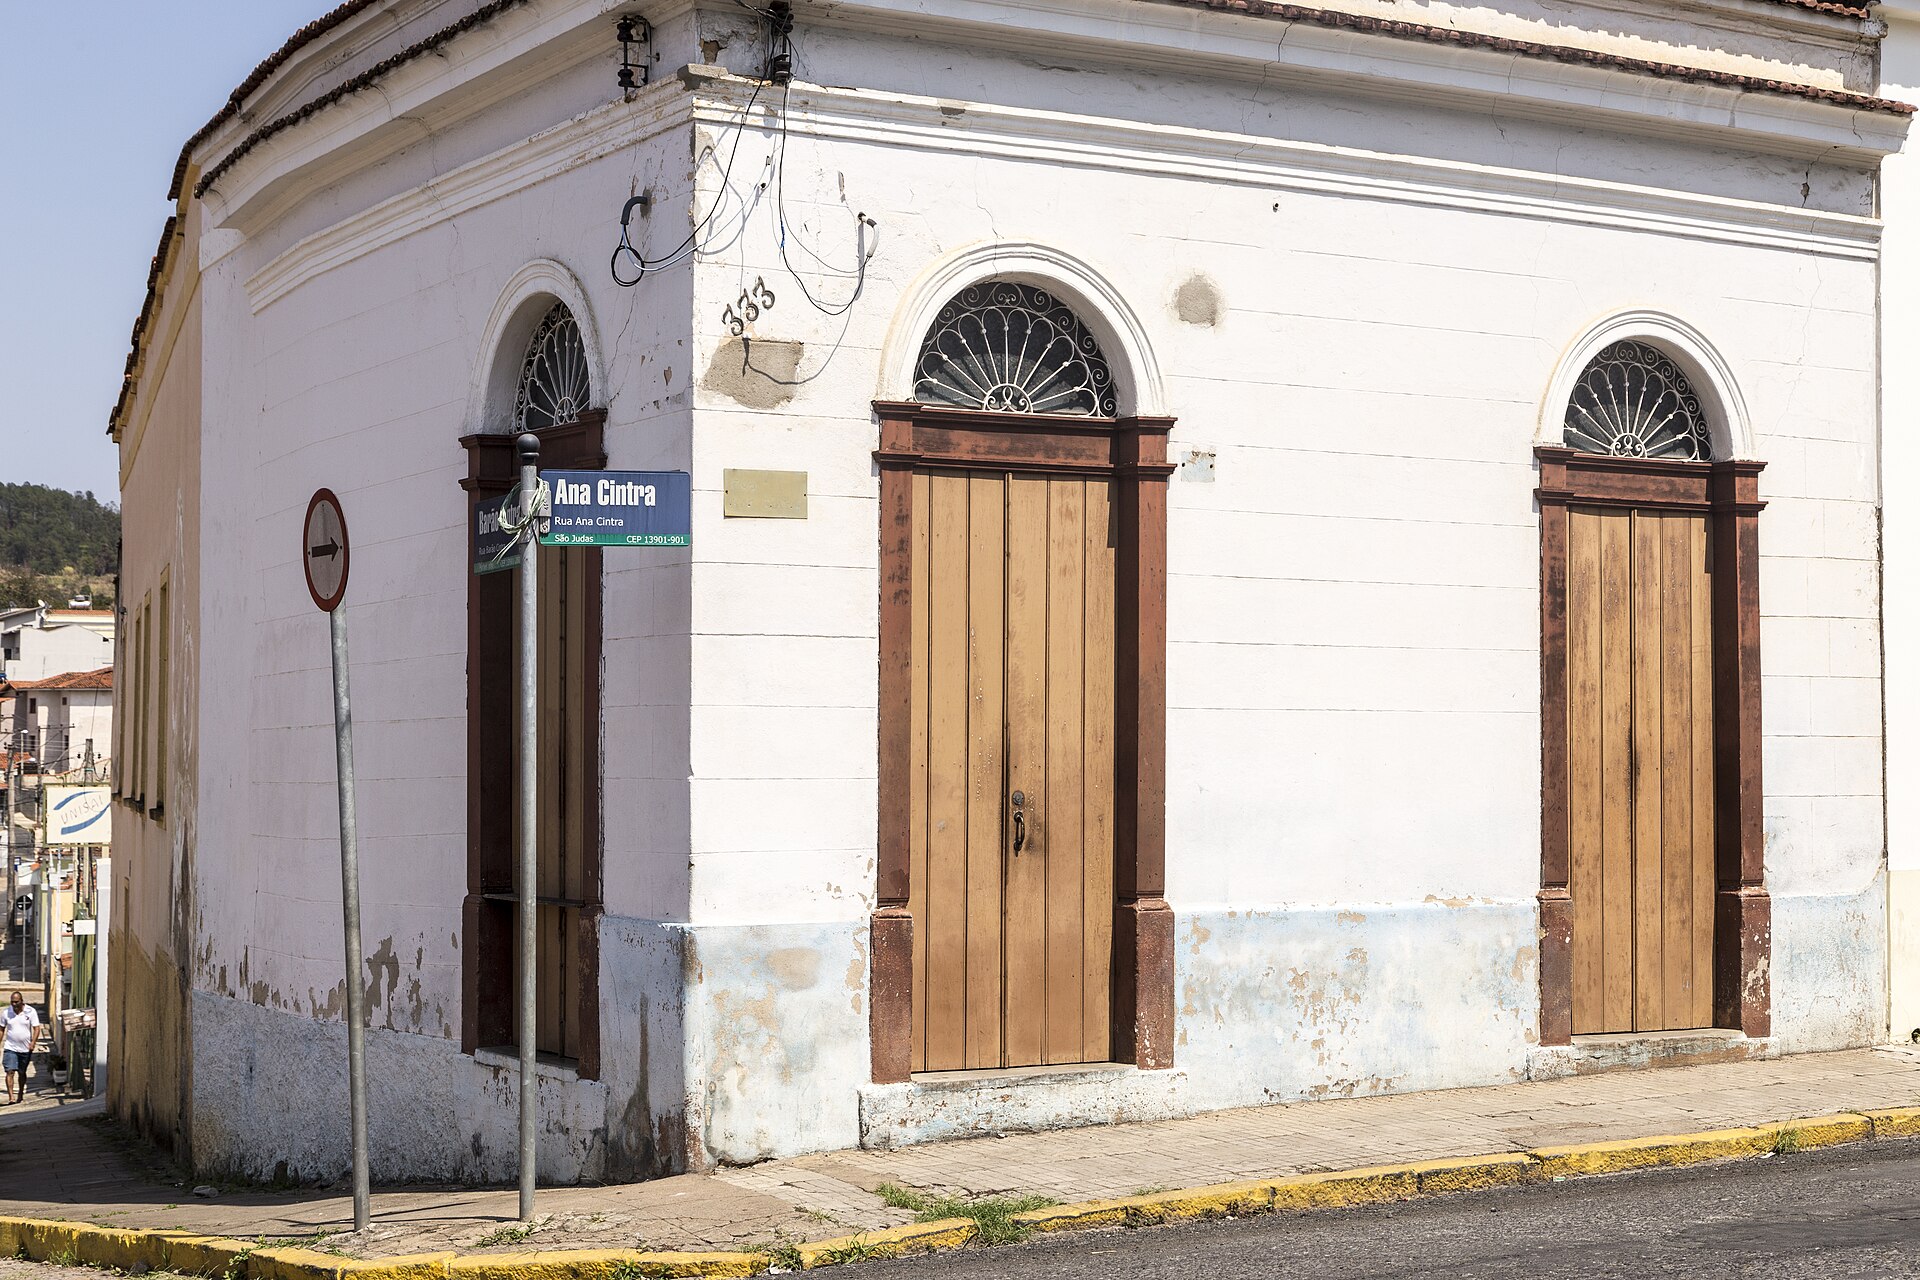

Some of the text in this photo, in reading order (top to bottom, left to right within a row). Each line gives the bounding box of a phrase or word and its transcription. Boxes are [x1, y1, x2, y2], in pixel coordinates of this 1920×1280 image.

[722, 275, 775, 336] 333
[554, 479, 656, 507] Ana Cintra
[479, 508, 499, 535] Barão
[554, 517, 624, 527] Rua Ana Cintra
[554, 534, 685, 544] São Judas CEP 13901-901
